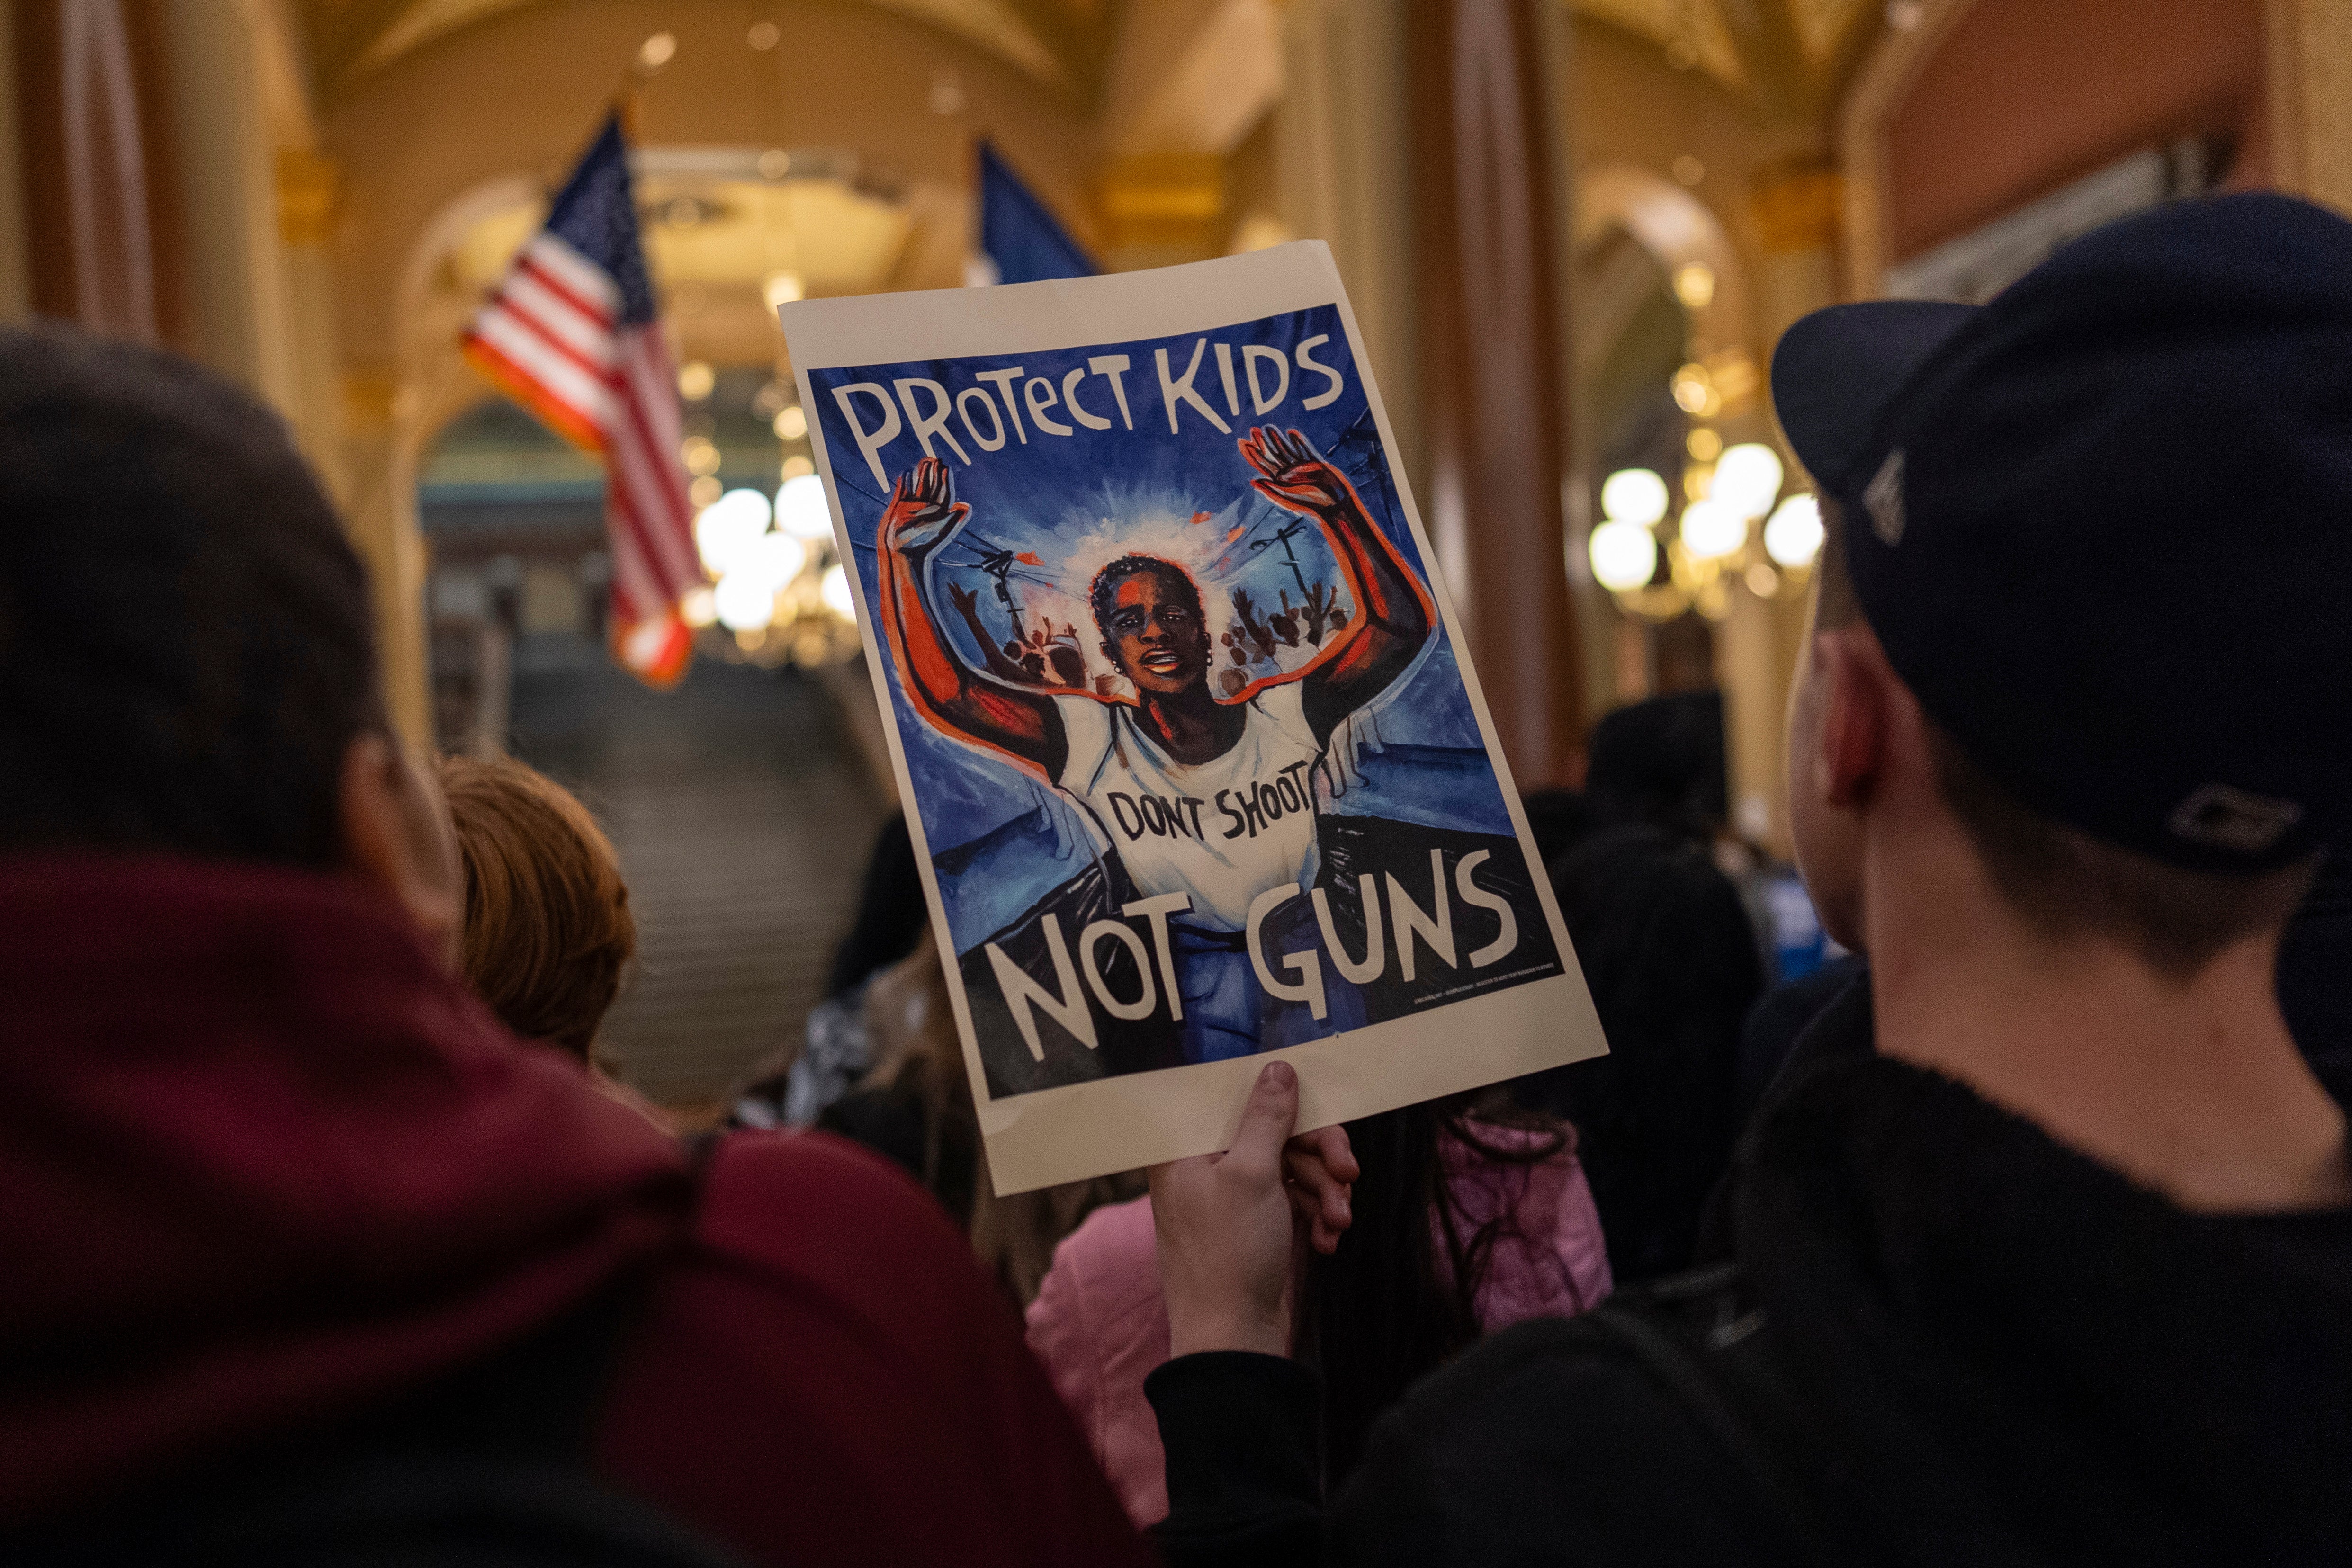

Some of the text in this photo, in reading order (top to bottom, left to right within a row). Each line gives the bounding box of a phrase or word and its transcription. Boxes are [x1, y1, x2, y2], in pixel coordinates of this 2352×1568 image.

[1154, 335, 1345, 435] KIDS
[1107, 759, 1311, 841] DONT SHOOT
[985, 848, 1518, 1062] NOT GUNS
